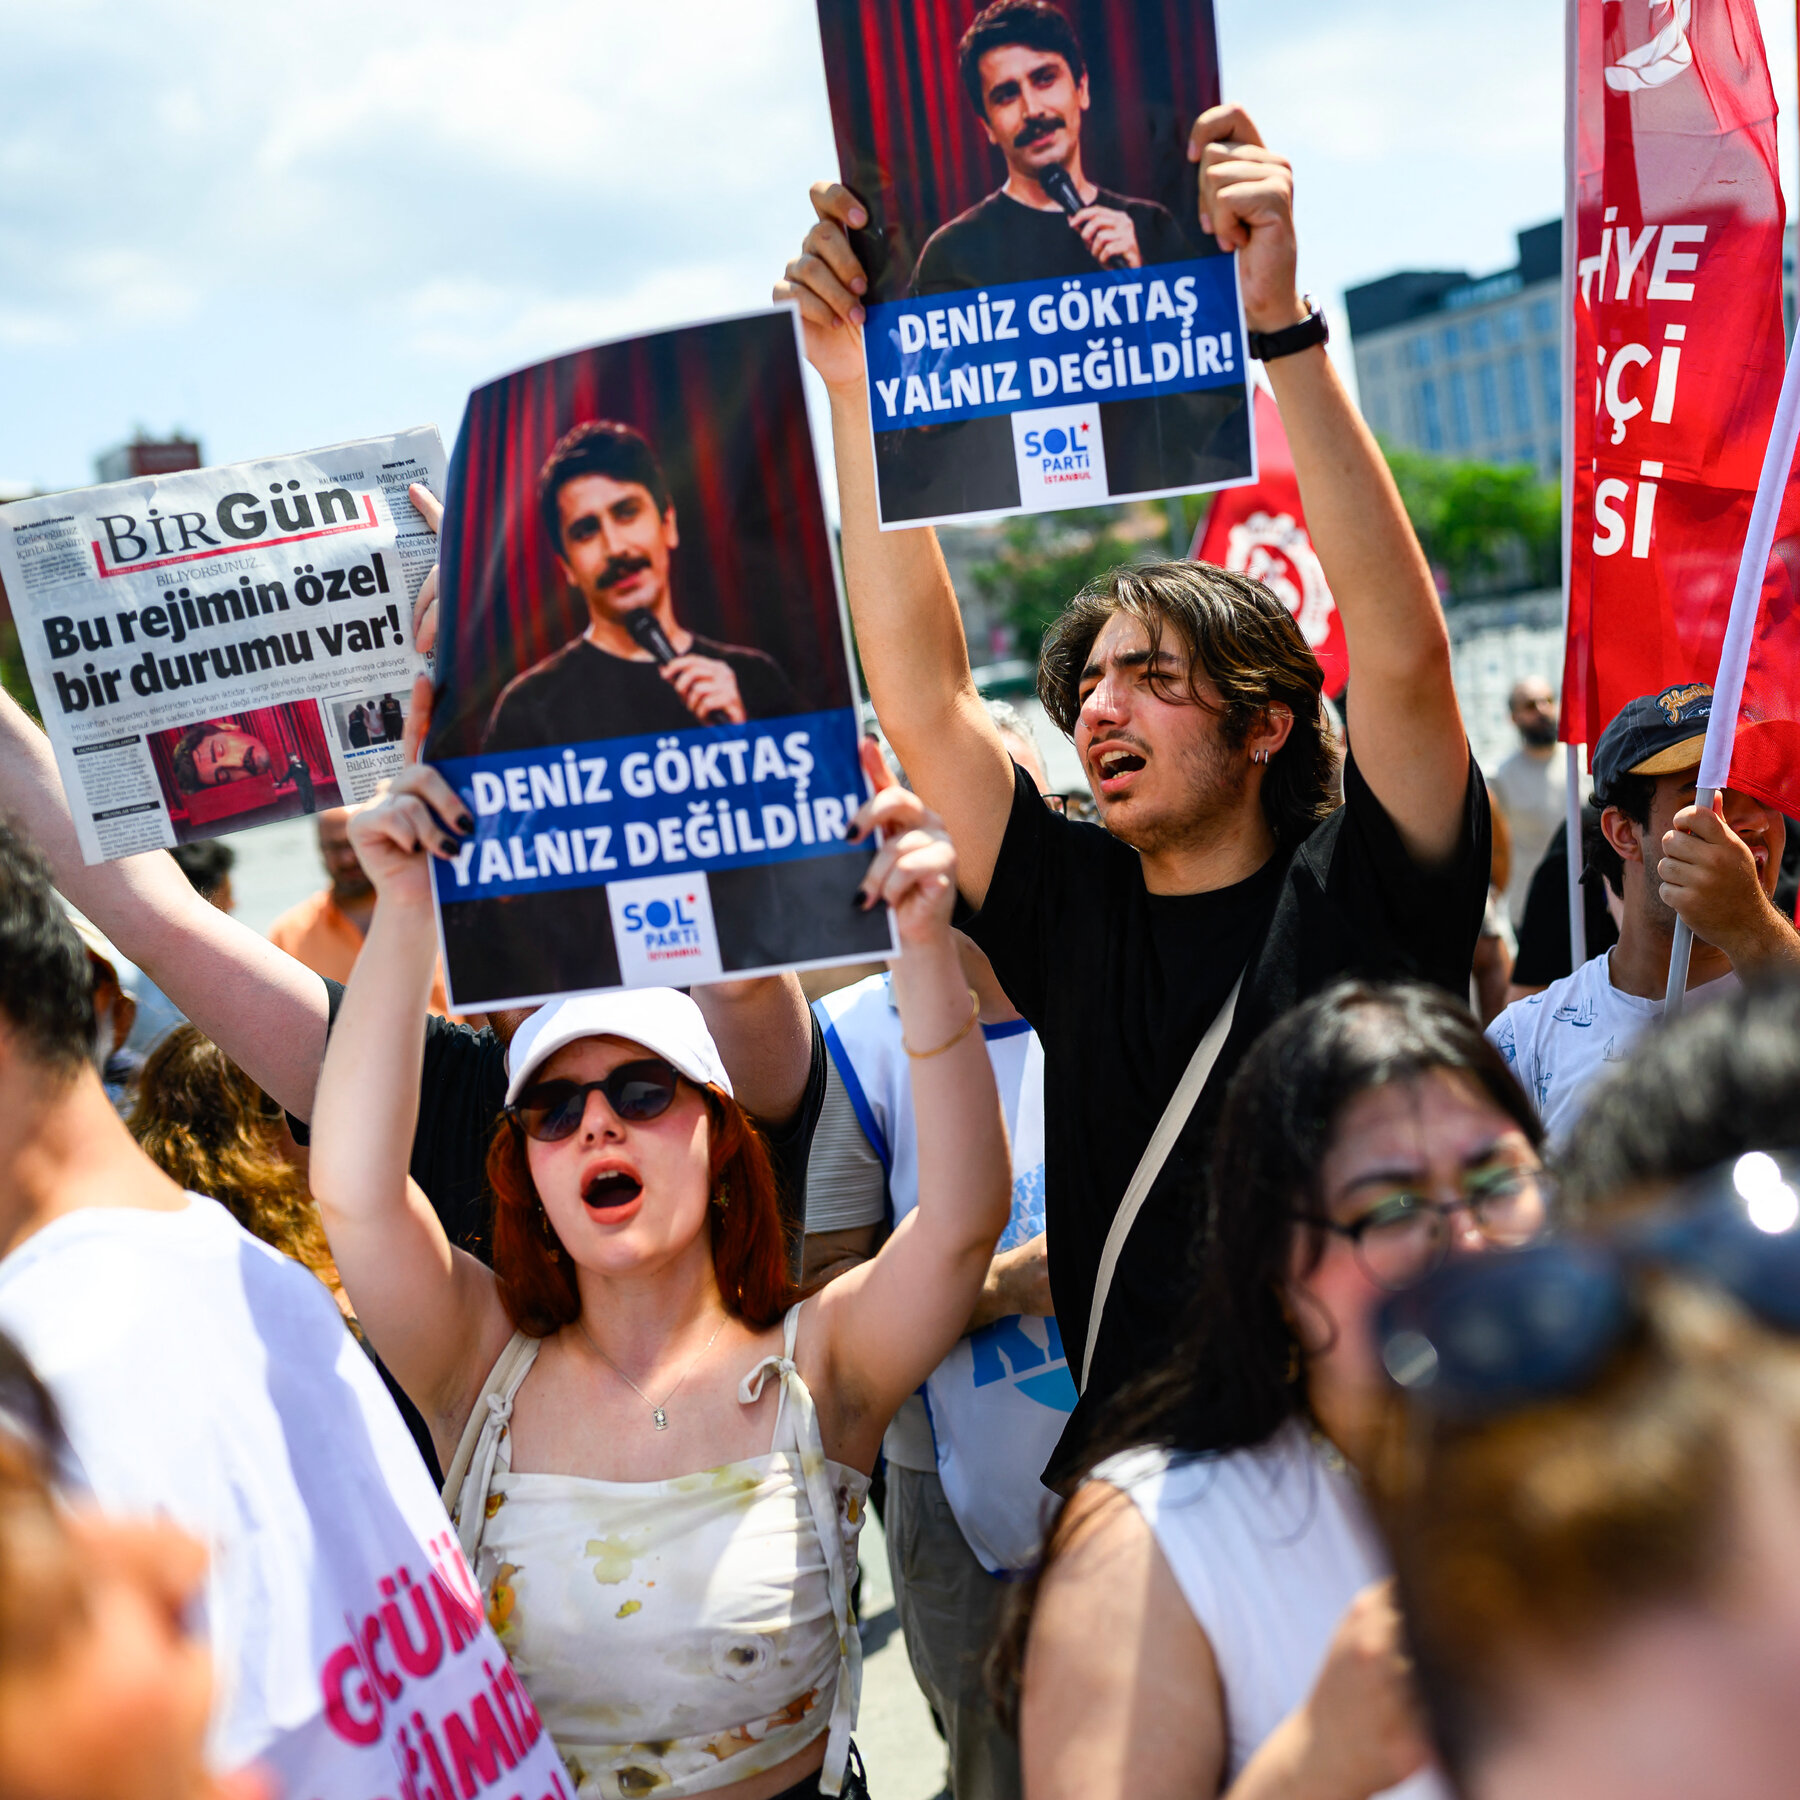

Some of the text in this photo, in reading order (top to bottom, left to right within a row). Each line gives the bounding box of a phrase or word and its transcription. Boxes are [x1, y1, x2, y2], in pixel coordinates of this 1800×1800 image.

[899, 277, 1198, 354] DENİZ GÖKTAŞ
[876, 326, 1233, 416] YALNIZ DEĞİLDİR!
[1596, 324, 1686, 445] Çİ
[1025, 426, 1087, 457] SOL
[1043, 454, 1089, 472] PARTİ
[96, 480, 360, 564] BİRGün
[396, 535, 428, 551] Protokol
[1592, 459, 1664, 559] Sİ
[43, 616, 112, 659] Bu
[118, 576, 290, 643] rejimin
[295, 553, 389, 606] özel
[53, 605, 404, 713] bir durumu var!
[346, 756, 376, 772] Bildik
[473, 751, 611, 816] DENİZ
[621, 733, 814, 797] GÖKTAŞ
[451, 827, 616, 886] YALNIZ
[624, 899, 694, 932] SOL
